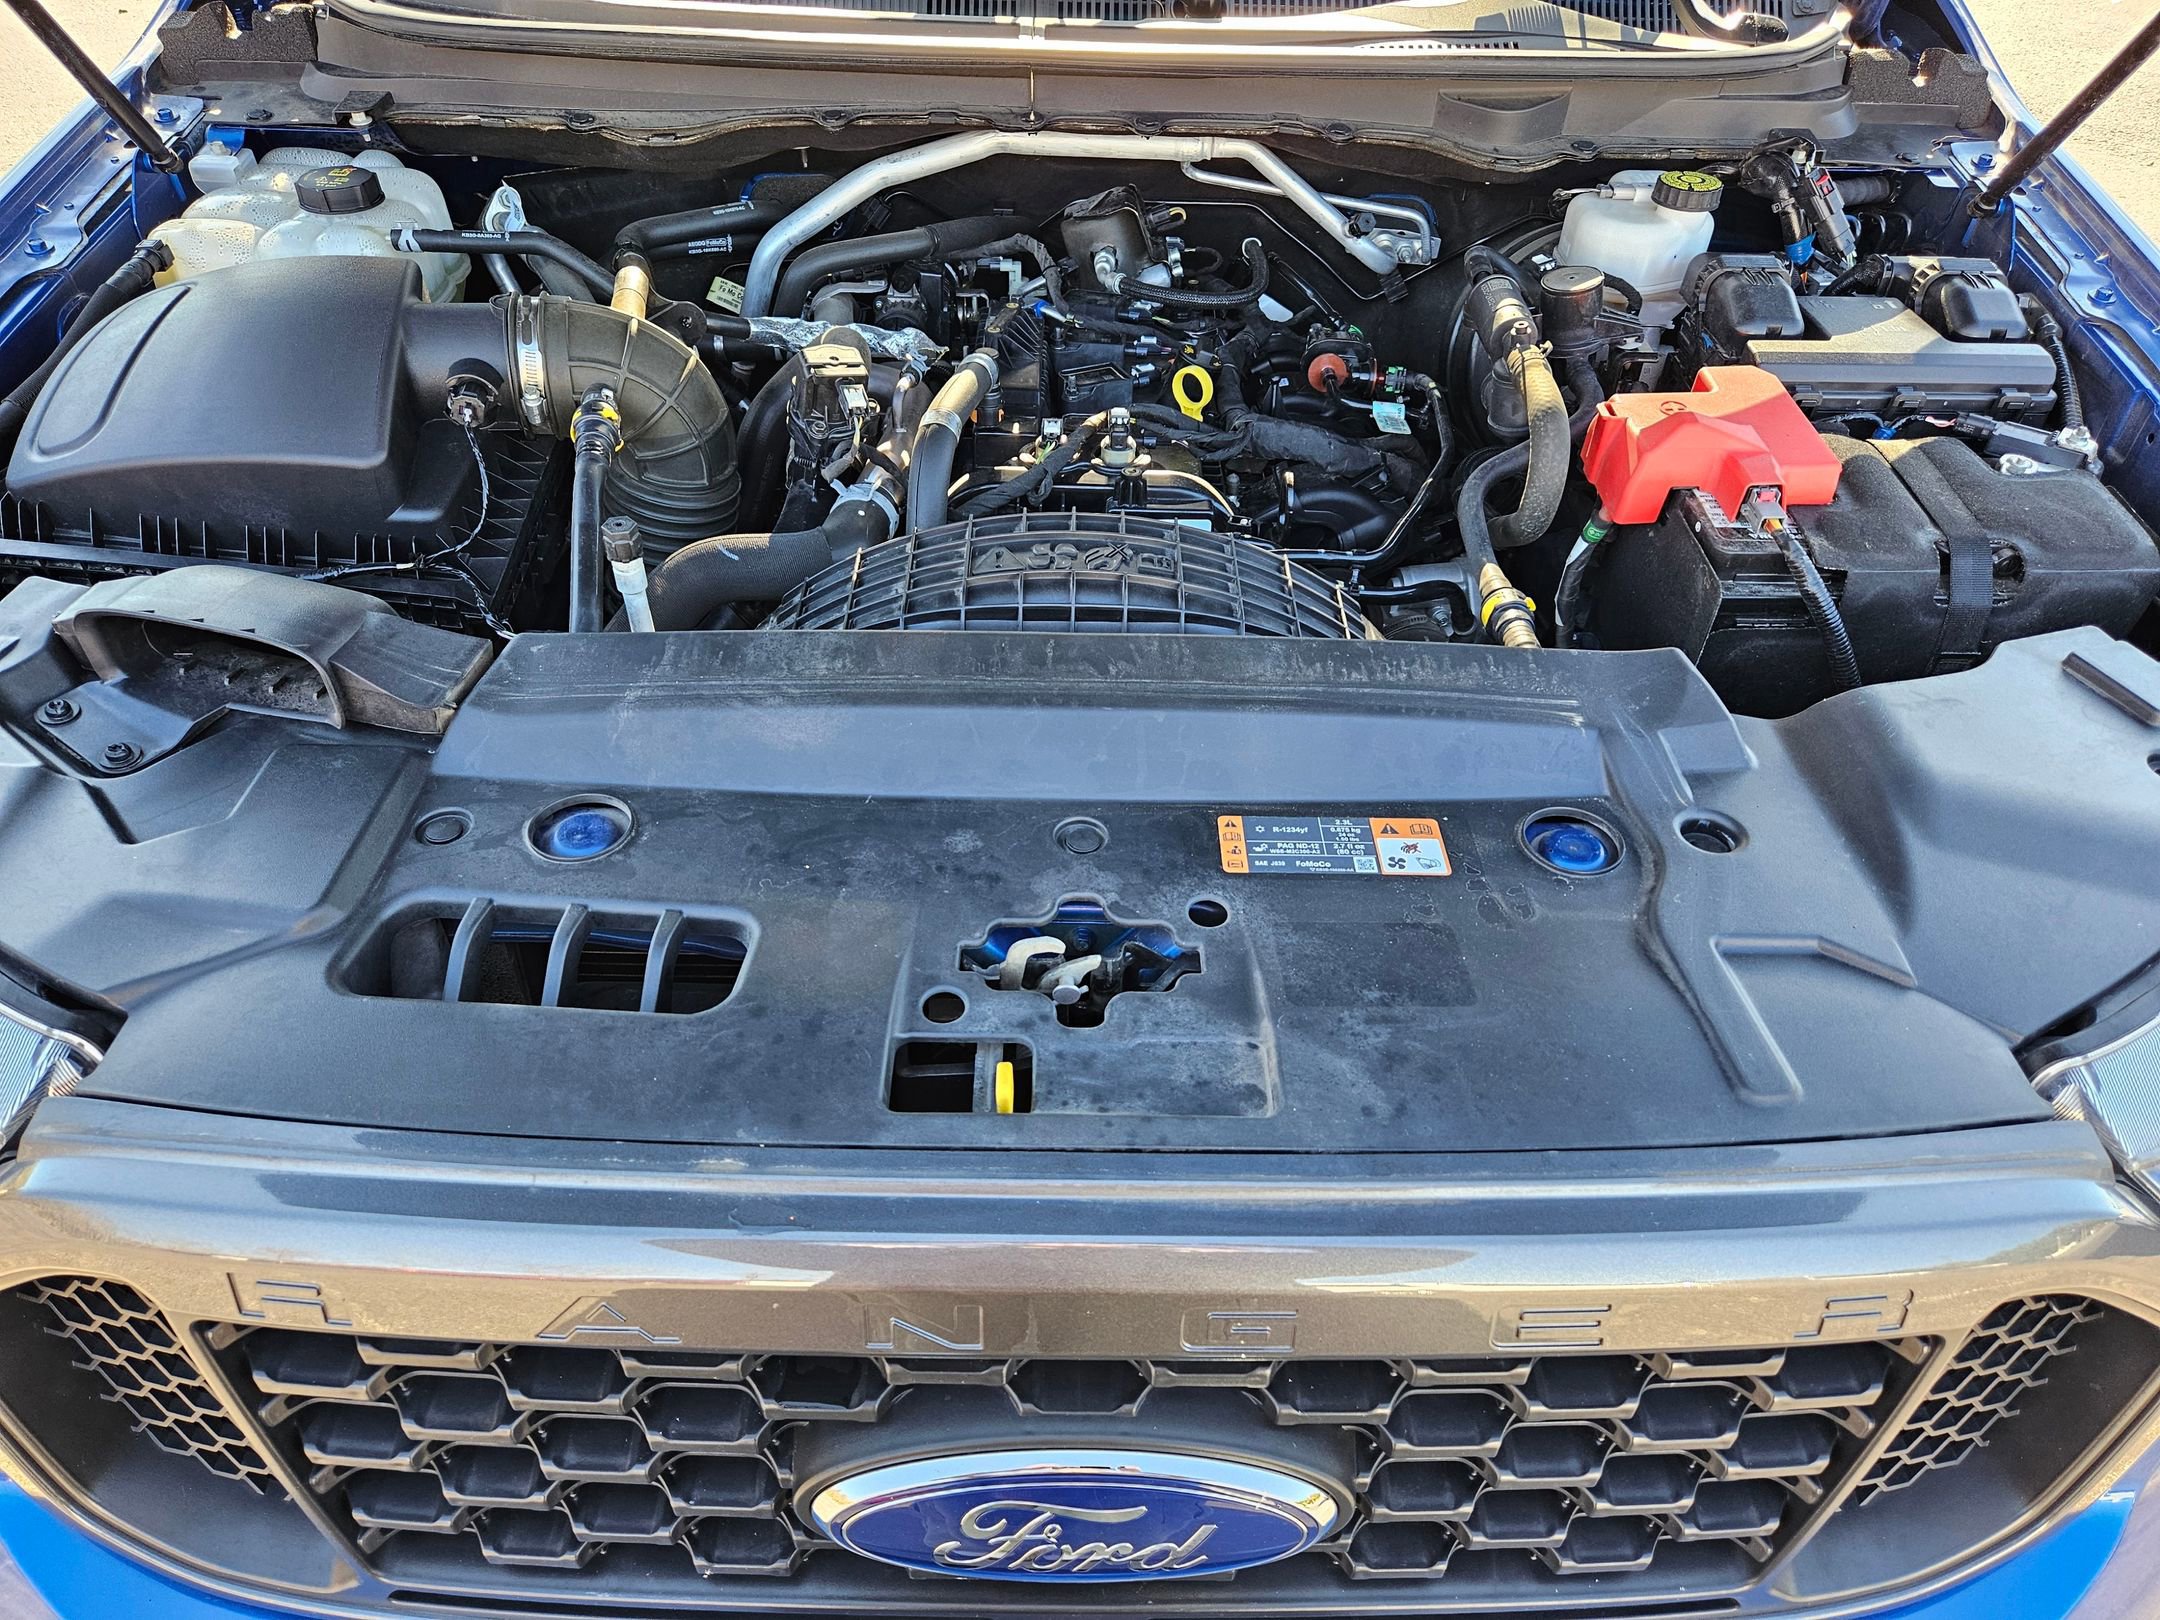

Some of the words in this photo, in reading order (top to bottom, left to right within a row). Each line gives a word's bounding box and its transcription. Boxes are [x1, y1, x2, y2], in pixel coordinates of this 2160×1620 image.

[1272, 826, 1309, 835] R-1234yf
[1295, 860, 1332, 868] FoMoCo
[226, 1271, 1914, 1353] RANGER
[933, 1498, 1219, 1572] Ford
